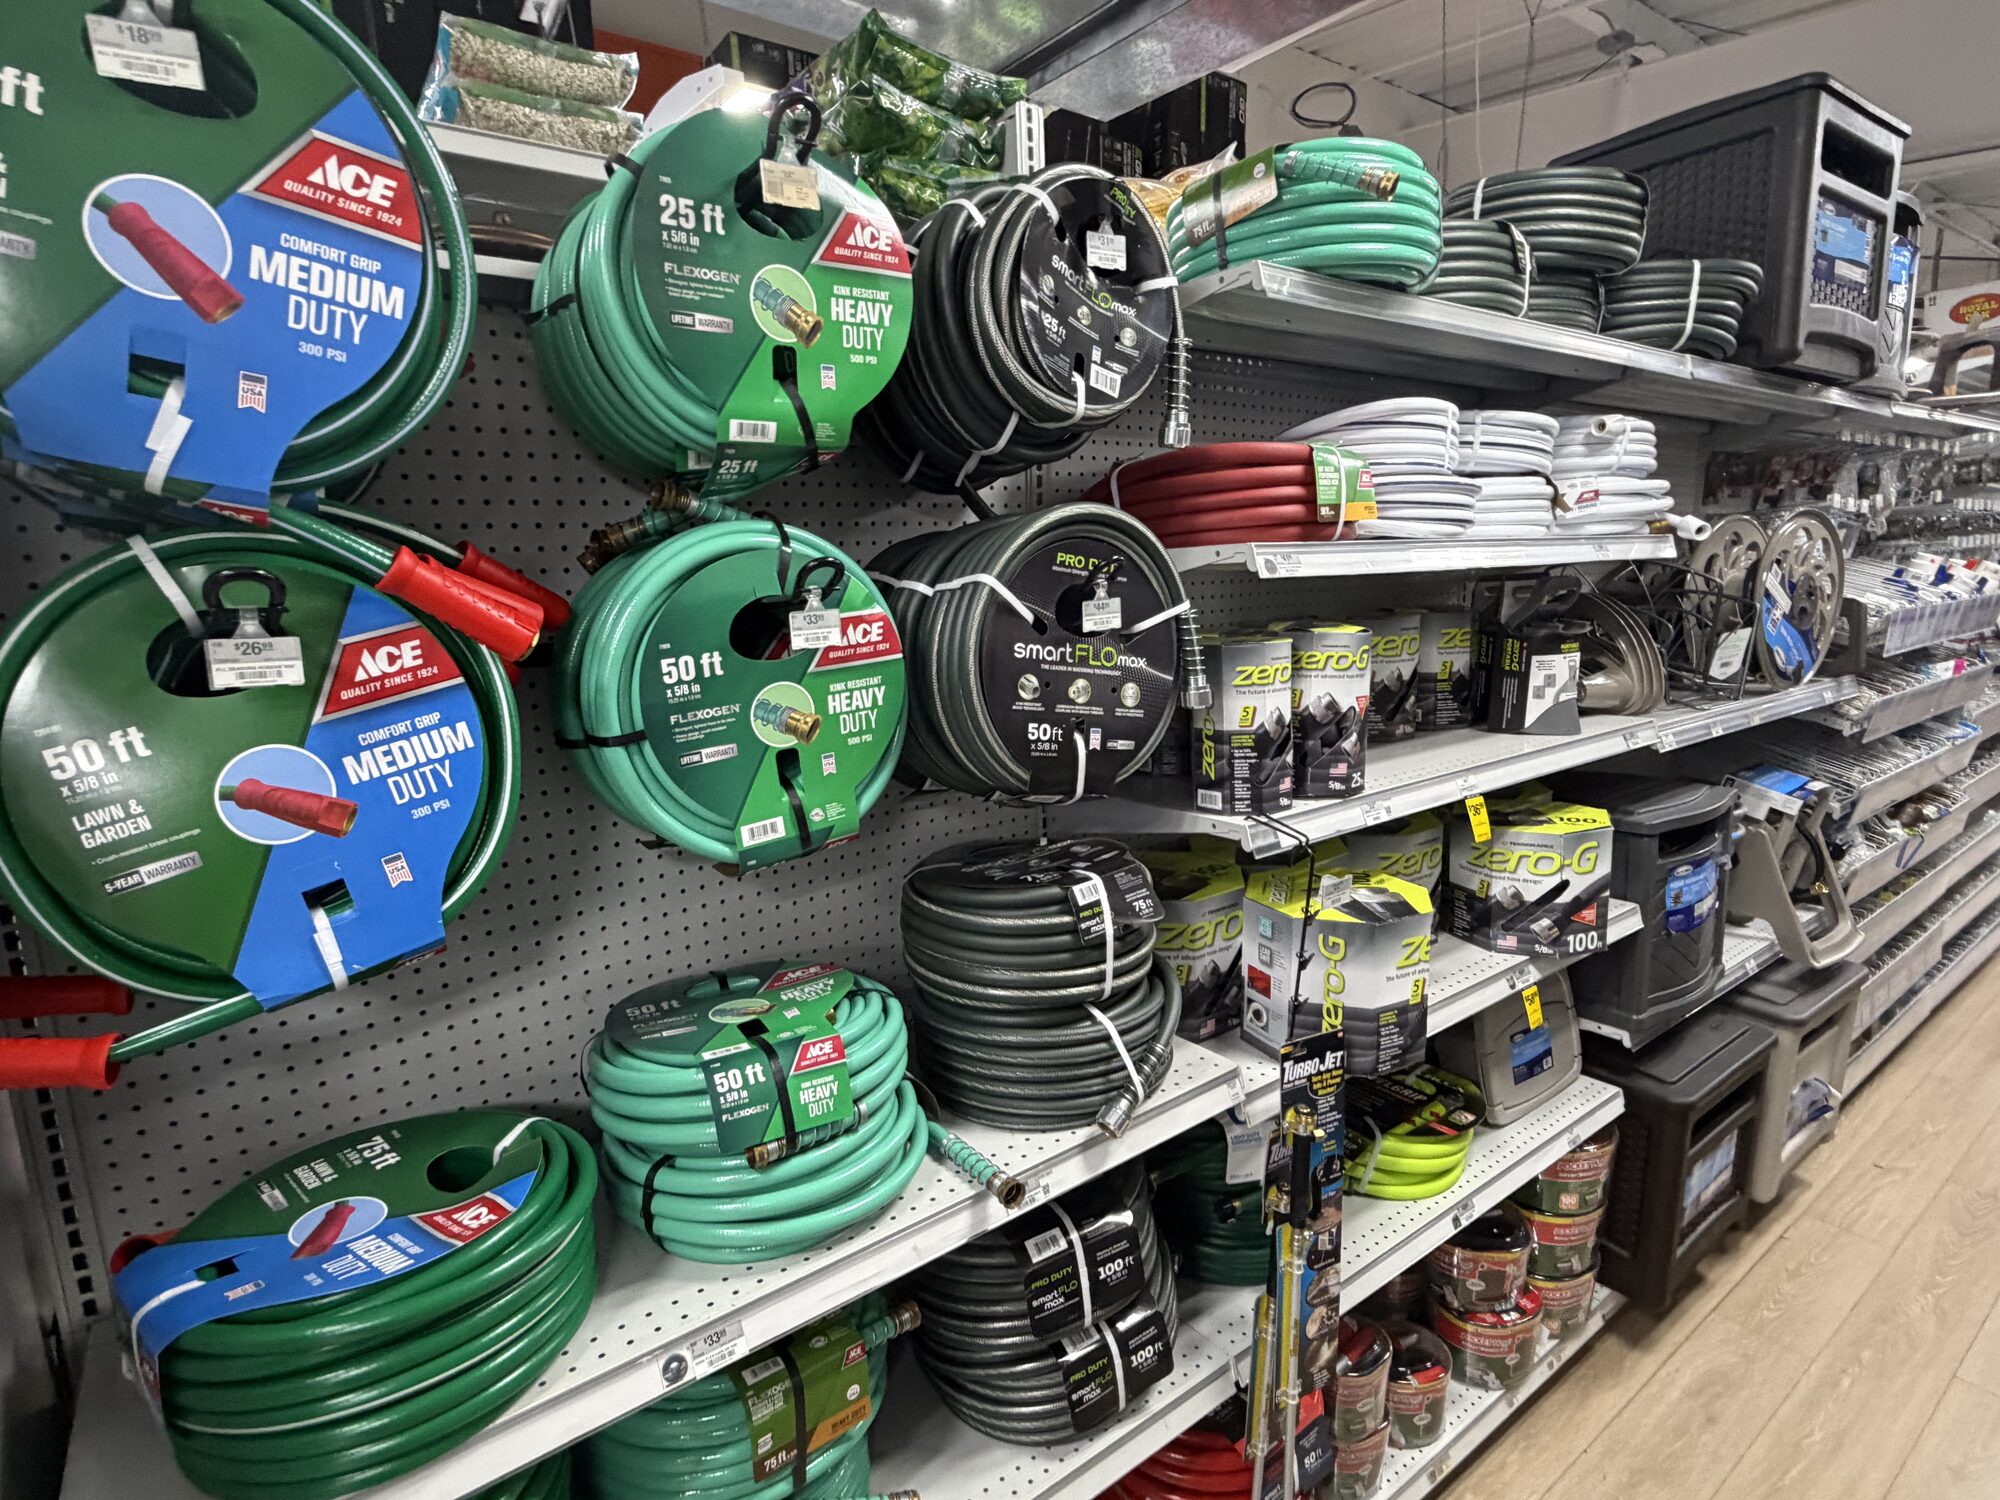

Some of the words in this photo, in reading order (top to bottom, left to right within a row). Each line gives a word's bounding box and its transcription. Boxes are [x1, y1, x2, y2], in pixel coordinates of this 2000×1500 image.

[0, 65, 44, 116] ft
[306, 154, 398, 208] ACE
[283, 179, 334, 204] QUALITY
[337, 196, 374, 217] SINCE
[377, 209, 403, 227] 1924
[659, 194, 697, 230] 25
[701, 202, 726, 235] ft
[662, 230, 671, 242] x
[671, 229, 688, 245] 5/8
[690, 232, 700, 247] in
[846, 222, 894, 251] ACE
[280, 232, 348, 265] COMFORT
[350, 254, 382, 274] GRIP
[834, 247, 861, 259] QUALITY
[863, 251, 883, 262] SINCE
[249, 244, 405, 320] MEDIUM
[664, 262, 740, 285] FLEXOGEN
[833, 284, 851, 297] KINK
[852, 287, 890, 301] RESISTANT
[287, 294, 369, 345] DUTY
[831, 297, 893, 327] HEAVY
[1043, 313, 1059, 333] 25
[842, 326, 884, 351] DUTY
[298, 341, 323, 357] 300
[326, 347, 347, 363] PSI
[865, 355, 878, 365] PSI
[241, 385, 263, 398] USA
[718, 459, 740, 474] 25
[742, 459, 758, 474] ft
[1056, 552, 1085, 569] PRO
[840, 621, 884, 645] ACE
[353, 639, 424, 682] ACE
[828, 648, 854, 659] QUALITY
[856, 645, 875, 655] SINCE
[660, 654, 696, 684] 50
[700, 651, 724, 678] ft
[340, 683, 382, 700] QUALITY
[384, 674, 414, 689] SINCE
[416, 665, 439, 680] 1924
[666, 689, 673, 698] x
[673, 685, 690, 697] 5/8
[691, 683, 701, 694] in
[829, 681, 846, 692] KINK
[847, 676, 882, 690] RESISTANT
[828, 686, 886, 715] HEAVY
[1242, 706, 1250, 717] 5
[670, 703, 740, 725] FLEXOGEN
[839, 710, 878, 735] DUTY
[357, 719, 413, 746] COMFORT
[415, 711, 441, 731] GRIP
[861, 735, 873, 744] PSI
[1027, 723, 1051, 740] 50
[1052, 726, 1063, 741] ft
[41, 737, 105, 781] 50
[108, 726, 153, 763] ft
[341, 720, 475, 786] MEDIUM
[704, 746, 735, 760] WARRANTY
[1050, 742, 1058, 750] in
[60, 784, 71, 798] x
[72, 776, 100, 794] 5/8
[101, 771, 119, 787] in
[386, 759, 454, 806] DUTY
[72, 804, 124, 832] LAWN
[128, 799, 145, 816] &
[410, 806, 432, 820] 300
[432, 798, 451, 813] PSI
[80, 814, 153, 850] GARDEN
[104, 872, 142, 894] 5-YEAR
[144, 855, 197, 880] WARRANTY
[388, 864, 406, 875] USA
[1080, 909, 1092, 918] PRO
[1132, 899, 1147, 913] 75
[1147, 898, 1154, 907] ft
[1176, 965, 1184, 976] 5
[781, 978, 835, 1001] HEAVY
[1413, 979, 1420, 993] 5
[626, 1004, 657, 1017] 50
[660, 1000, 682, 1011] ft
[806, 1040, 834, 1059] ACE
[713, 1070, 743, 1094] 50
[745, 1062, 766, 1085] ft
[1283, 1057, 1320, 1084] TURBO
[1319, 1050, 1344, 1072] JET
[720, 1096, 725, 1104] x
[726, 1092, 739, 1103] 5/8
[740, 1090, 748, 1100] in
[799, 1081, 839, 1105] HEAVY
[721, 1103, 770, 1123] FLEXOGEN
[808, 1097, 834, 1118] DUTY
[356, 1135, 391, 1158] 75
[310, 1158, 335, 1178] LAWN
[370, 1152, 402, 1170] ft
[293, 1165, 323, 1190] GARDEN
[451, 1202, 499, 1229] ACE
[346, 1234, 415, 1275] MEDIUM
[321, 1254, 371, 1281] DUTY
[1031, 1277, 1050, 1290] PRO
[1051, 1265, 1073, 1283] DUTY
[1097, 1258, 1124, 1280] 100
[1124, 1255, 1135, 1269] ft
[1044, 1295, 1065, 1311] max
[1130, 1345, 1157, 1368] 100
[1157, 1341, 1164, 1354] ft
[1070, 1370, 1087, 1383] PRO
[1087, 1356, 1109, 1374] DUTY
[1083, 1388, 1102, 1403] max
[764, 1457, 777, 1473] 75
[1304, 1452, 1316, 1468] 50
